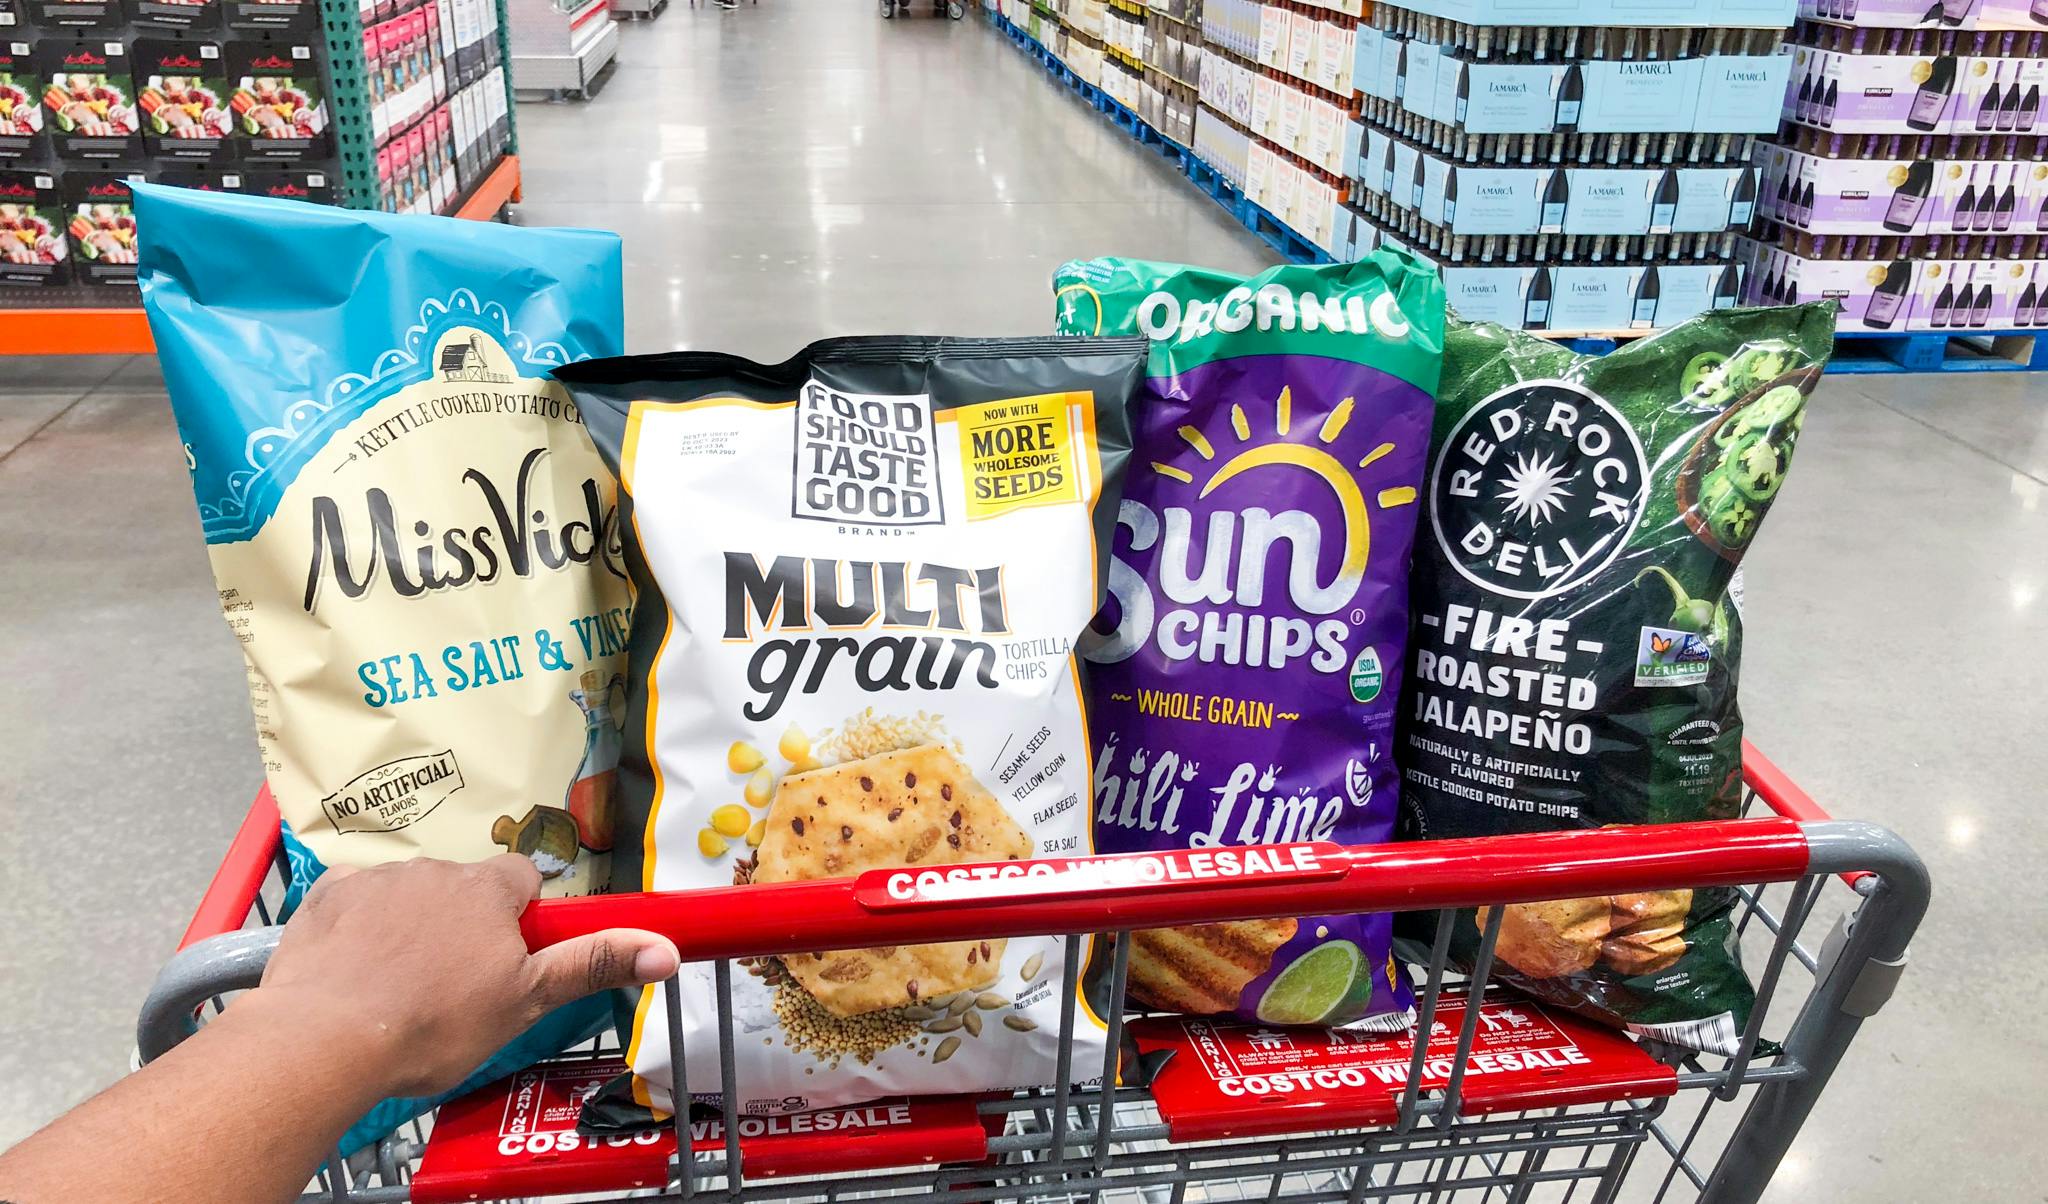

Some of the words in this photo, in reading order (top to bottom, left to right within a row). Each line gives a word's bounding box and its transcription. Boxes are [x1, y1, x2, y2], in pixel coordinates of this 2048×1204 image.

[1136, 283, 1410, 345] ORGANIC
[356, 401, 434, 457] KETTLE
[430, 392, 492, 419] COOKED
[496, 393, 561, 419] POTATO
[806, 384, 923, 433] FOOD
[984, 407, 1008, 421] NOW
[1010, 403, 1039, 417] WITH
[806, 413, 927, 457] SHOULD
[971, 422, 1056, 460] MORE
[805, 441, 928, 489] TASTE
[974, 453, 1060, 473] WHOLESOME
[975, 466, 1064, 500] SEEDS
[1449, 407, 1522, 498] RED
[1544, 400, 1631, 525] ROCK
[806, 477, 930, 518] GOOD
[304, 487, 498, 612] Miss
[1460, 521, 1580, 577] DELI
[722, 551, 1009, 642] MULTI
[1080, 497, 1371, 664] Sun
[1002, 637, 1072, 660] TORTILLA
[1157, 608, 1350, 673] CHIPS
[358, 653, 438, 708] SEA
[442, 635, 524, 692] SALT
[535, 629, 574, 671] &
[743, 635, 999, 722] grain
[1006, 662, 1048, 680] CHIPS
[1354, 676, 1379, 688] ORGANIC
[1358, 659, 1376, 672] USDA
[1416, 649, 1598, 711] ROASTED
[1643, 662, 1706, 676] VERIFIED
[1137, 688, 1203, 722] WHOLE
[1207, 696, 1274, 729] GRAIN
[1415, 692, 1592, 755] JALAPEÑO
[1669, 720, 1710, 740] GUARANTEED
[999, 750, 1031, 785] SESAME
[1026, 726, 1052, 755] SEEDS
[1012, 771, 1046, 803] YELLOW
[1044, 752, 1067, 777] CORN
[1409, 734, 1469, 763] NATURALLY
[1472, 753, 1483, 766] &
[1485, 756, 1581, 782] ARTIFICIALLY
[1450, 763, 1515, 790] FLAVORED
[332, 797, 360, 819] NO
[363, 758, 455, 811] ARTIFICIAL
[378, 795, 418, 818] FLAVORS
[1033, 806, 1055, 826] FLAX
[1056, 792, 1078, 814] SEEDS
[1189, 761, 1343, 848] Lime
[1406, 767, 1440, 790] KETTLE
[1441, 781, 1484, 803] COOKED
[1486, 792, 1535, 813] POTATO
[1538, 802, 1580, 819] CHIPS
[1043, 839, 1060, 853] SEA
[1061, 836, 1078, 851] SALT
[1655, 972, 1681, 985] enlarged
[1670, 978, 1691, 988] texture
[1218, 1067, 1366, 1097] COSTCO
[1368, 1047, 1593, 1084] WHOLESALE
[1238, 1051, 1275, 1059] ALWAYS
